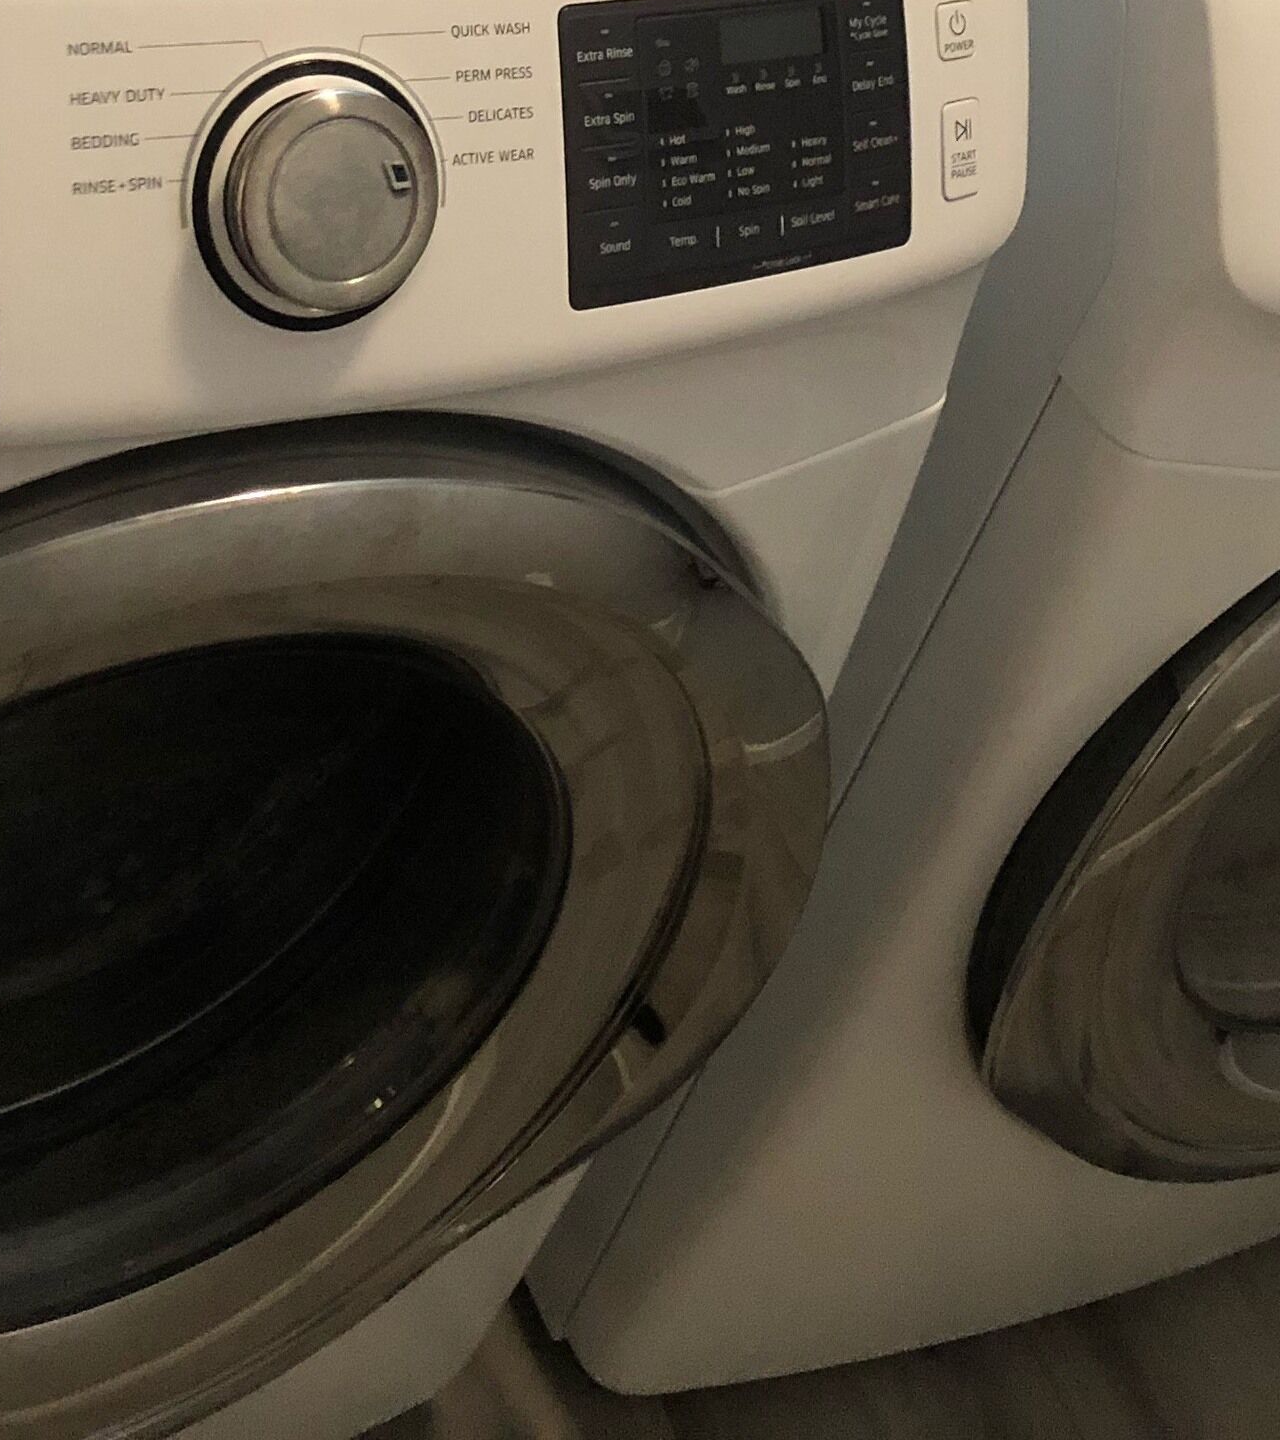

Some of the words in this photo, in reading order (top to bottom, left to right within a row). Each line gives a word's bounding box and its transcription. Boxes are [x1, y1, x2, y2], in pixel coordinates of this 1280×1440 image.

[451, 24, 490, 39] QUICK
[493, 22, 531, 36] WASH
[66, 40, 133, 57] NORMAL
[576, 50, 604, 63] Extra
[606, 46, 634, 59] Rinse
[944, 39, 975, 54] POWER
[455, 68, 491, 83] PERM
[495, 66, 533, 80] PRESS
[852, 79, 875, 92] Delay
[877, 74, 894, 88] End
[69, 90, 121, 106] HEAVY
[125, 87, 166, 103] DUTY
[468, 106, 534, 123] DELICATES
[584, 114, 611, 127] Extra
[613, 111, 635, 126] Spin
[735, 124, 756, 137] High
[71, 132, 140, 150] BEDDING
[669, 134, 686, 146] Hot
[452, 150, 495, 166] ACTIVE
[498, 147, 535, 163] WEAR
[736, 143, 771, 156] Medium
[951, 148, 977, 164] START
[670, 154, 698, 166] Warm
[671, 176, 688, 187] Eco
[688, 172, 716, 185] Warm
[737, 166, 756, 177] Low
[951, 165, 977, 179] PAUSE
[589, 176, 611, 191] Spin
[613, 173, 637, 187] Only
[737, 186, 751, 197] No
[752, 183, 771, 196] Spin
[671, 194, 692, 207] Cold
[790, 214, 809, 228] Soil
[810, 209, 836, 225] Level
[738, 223, 761, 239] Spin
[600, 238, 632, 255] Sound
